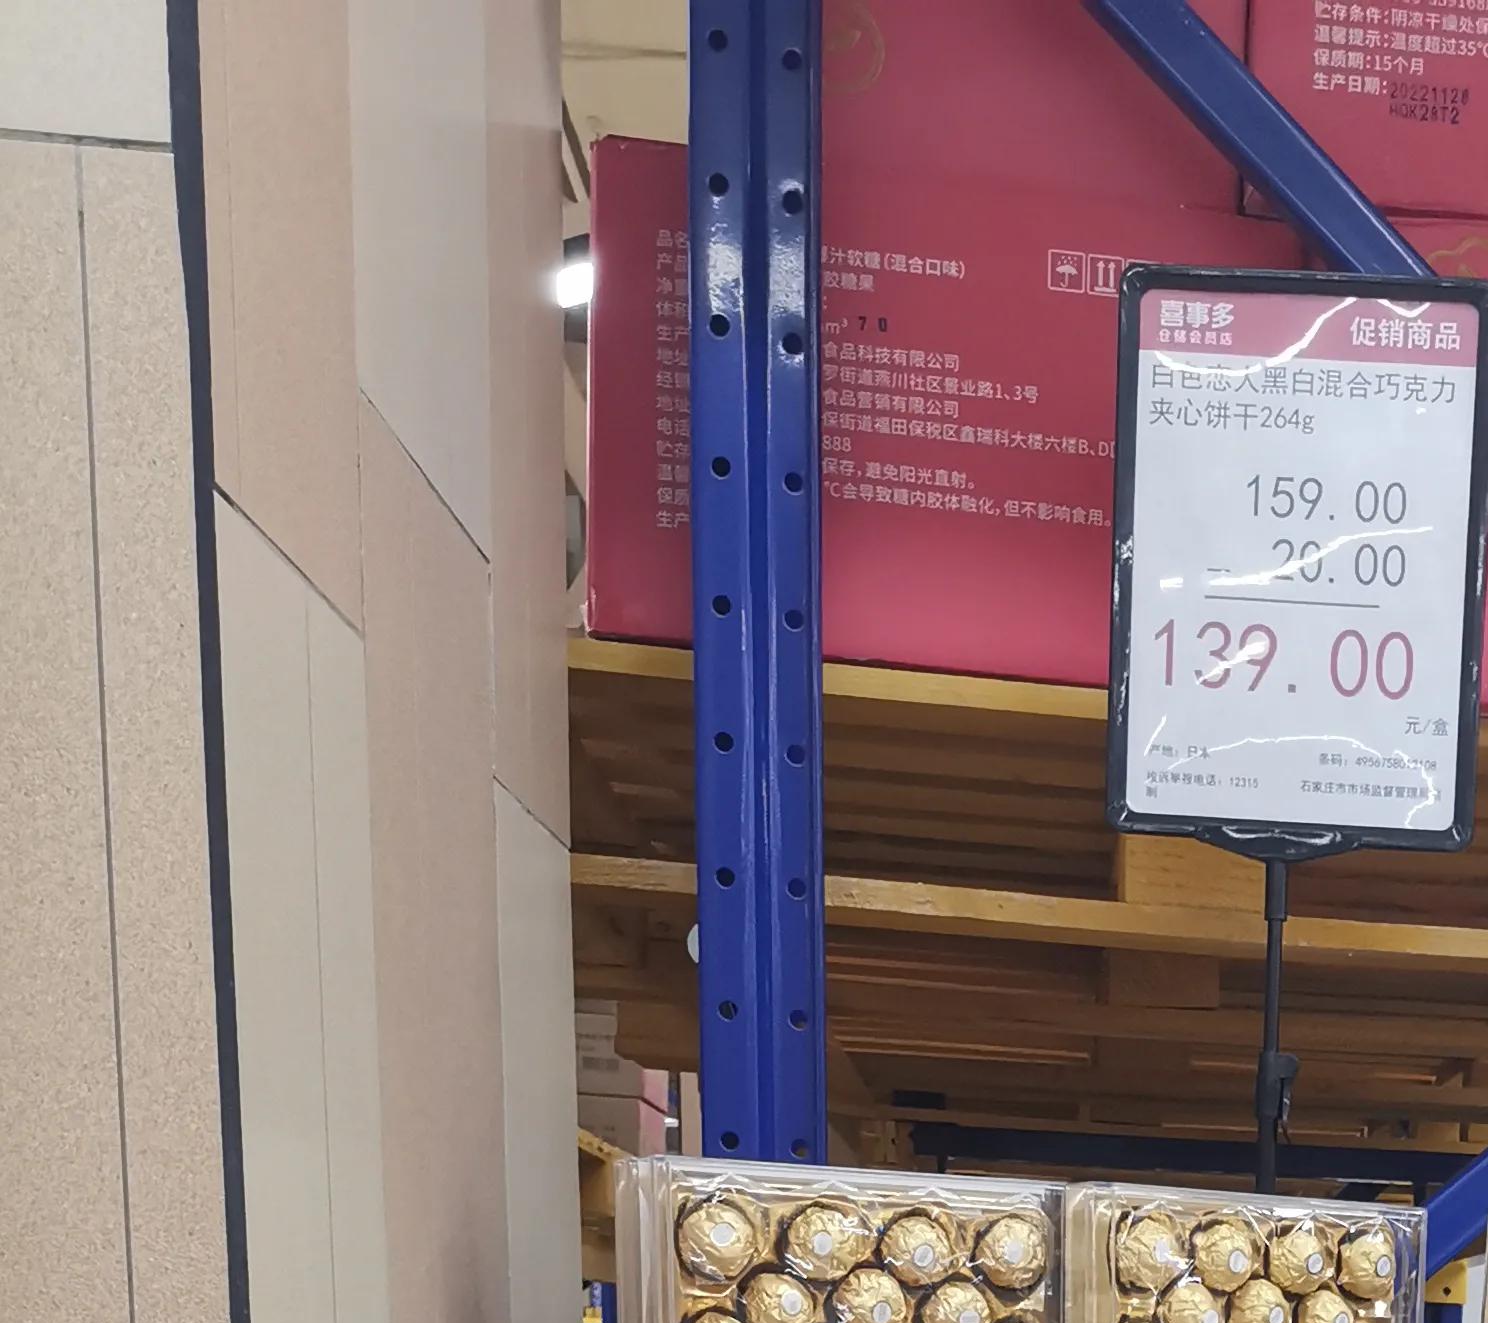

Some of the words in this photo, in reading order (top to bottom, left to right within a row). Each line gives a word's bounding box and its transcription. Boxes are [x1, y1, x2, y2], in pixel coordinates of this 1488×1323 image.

[1159, 329, 1233, 346] 仓储会员店
[1160, 300, 1234, 329] 喜事多
[1350, 316, 1461, 350] 促销商品
[1152, 364, 1456, 404] 白色恋人黑白混合巧克力
[1150, 398, 1314, 434] 夹心饼干264g
[1246, 475, 1407, 524] 159.00
[1154, 619, 1414, 700] 139.00
[1404, 716, 1449, 737] 元/盒
